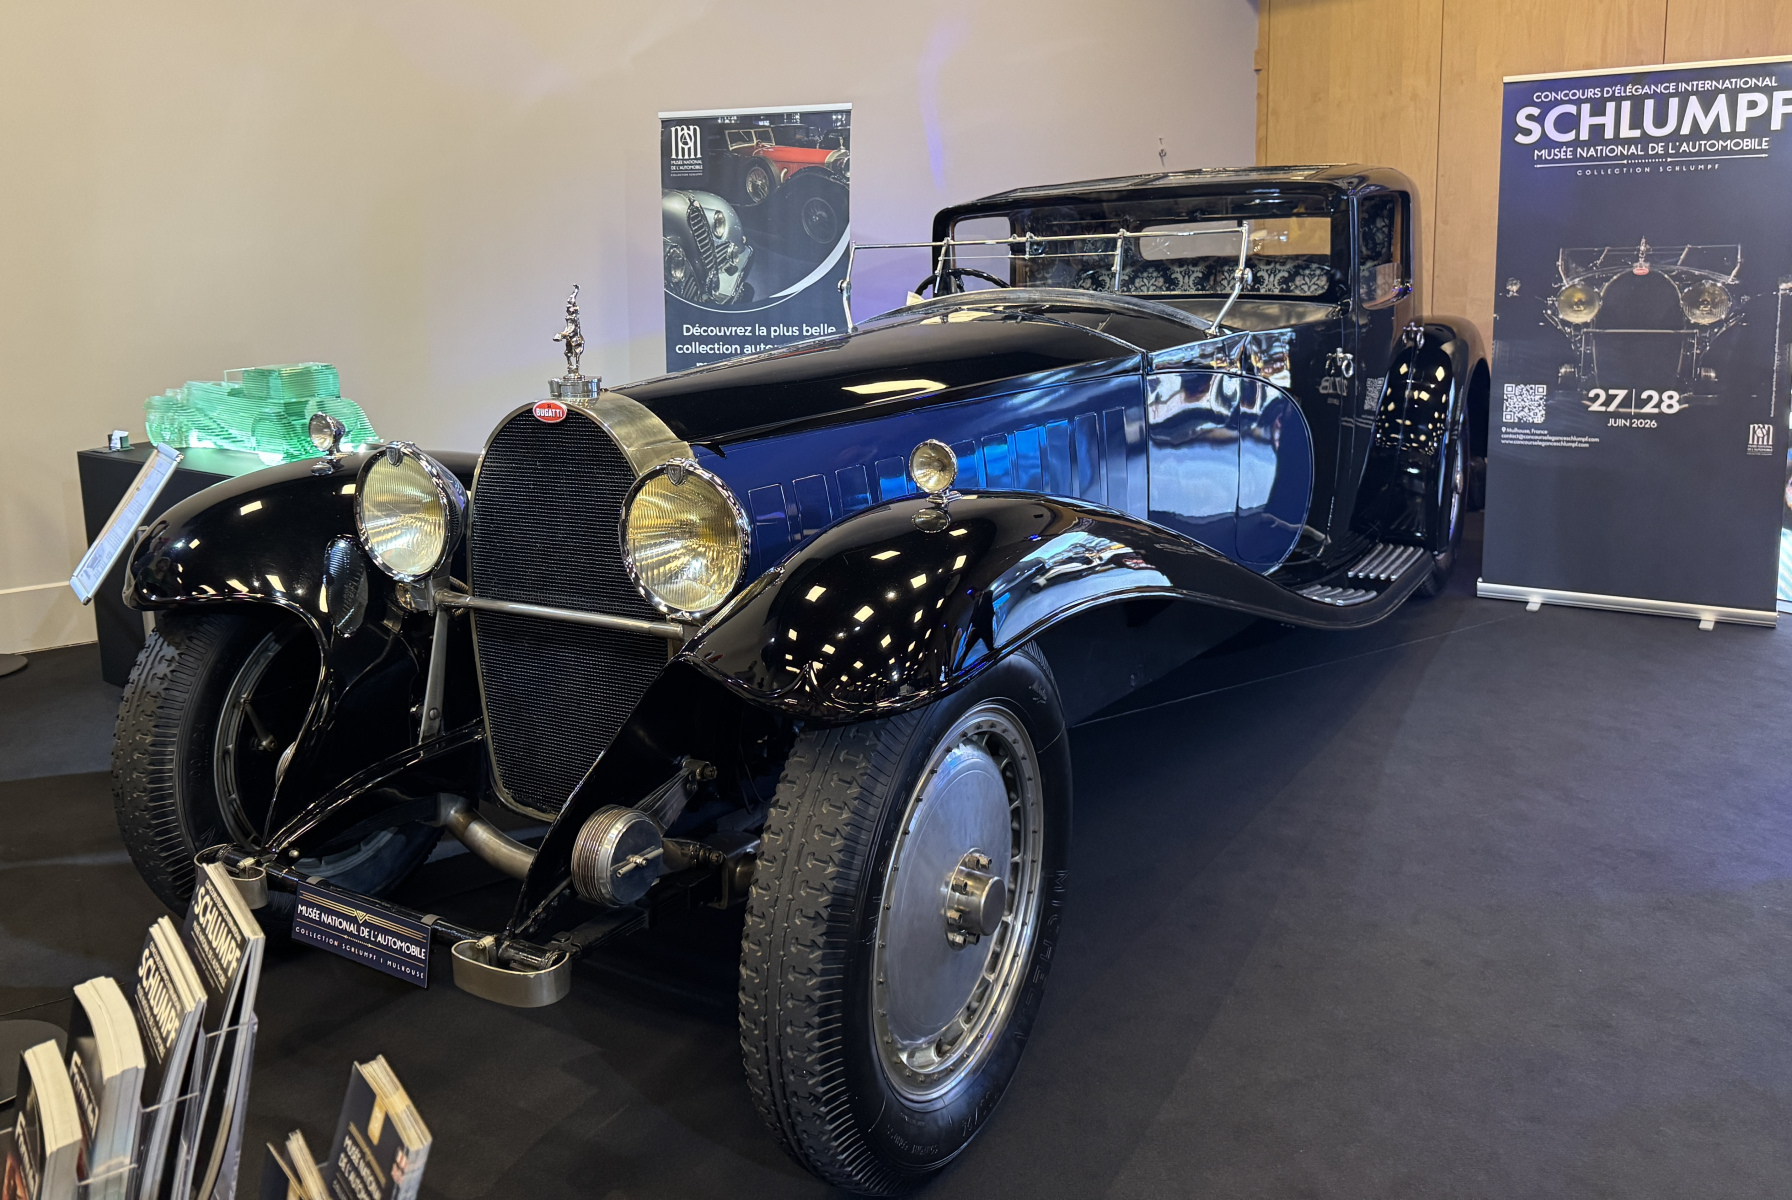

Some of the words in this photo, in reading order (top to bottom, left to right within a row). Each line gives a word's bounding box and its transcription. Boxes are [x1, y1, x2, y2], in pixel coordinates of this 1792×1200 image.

[1533, 87, 1601, 102] CONCOURS
[1603, 83, 1676, 98] D'ÉLÉGANCE
[1678, 76, 1778, 92] INTERNATIONAL
[1514, 91, 1792, 145] SCHLUMPF
[1533, 146, 1573, 160] MUSÉE
[1577, 142, 1644, 158] NATIONAL
[1648, 142, 1664, 154] DE
[1668, 137, 1770, 153] L'AUTOMOBILE
[1576, 166, 1650, 176] COLLECTION
[1659, 163, 1720, 172] SCHLUMPF
[682, 323, 751, 336] Découvrez
[755, 323, 767, 336] la
[770, 324, 799, 338] plus
[802, 323, 837, 336] belle
[675, 341, 741, 354] collection
[535, 408, 563, 418] BUGATTI
[1587, 388, 1629, 412] 27
[1640, 390, 1681, 414] 28
[1607, 418, 1630, 427] JUIN
[1631, 419, 1658, 428] 2026
[194, 886, 241, 977] SCHLUMPF
[297, 904, 320, 921] MUSÉE
[321, 912, 358, 935] NATIONAL
[360, 926, 369, 939] DE
[370, 930, 426, 960] L'AUTOMOBILE
[295, 927, 339, 947] COLLECTION
[342, 943, 377, 961] SCHLUMPF
[387, 960, 424, 979] MULHOUSE
[138, 948, 180, 1048] SCHLUMPF
